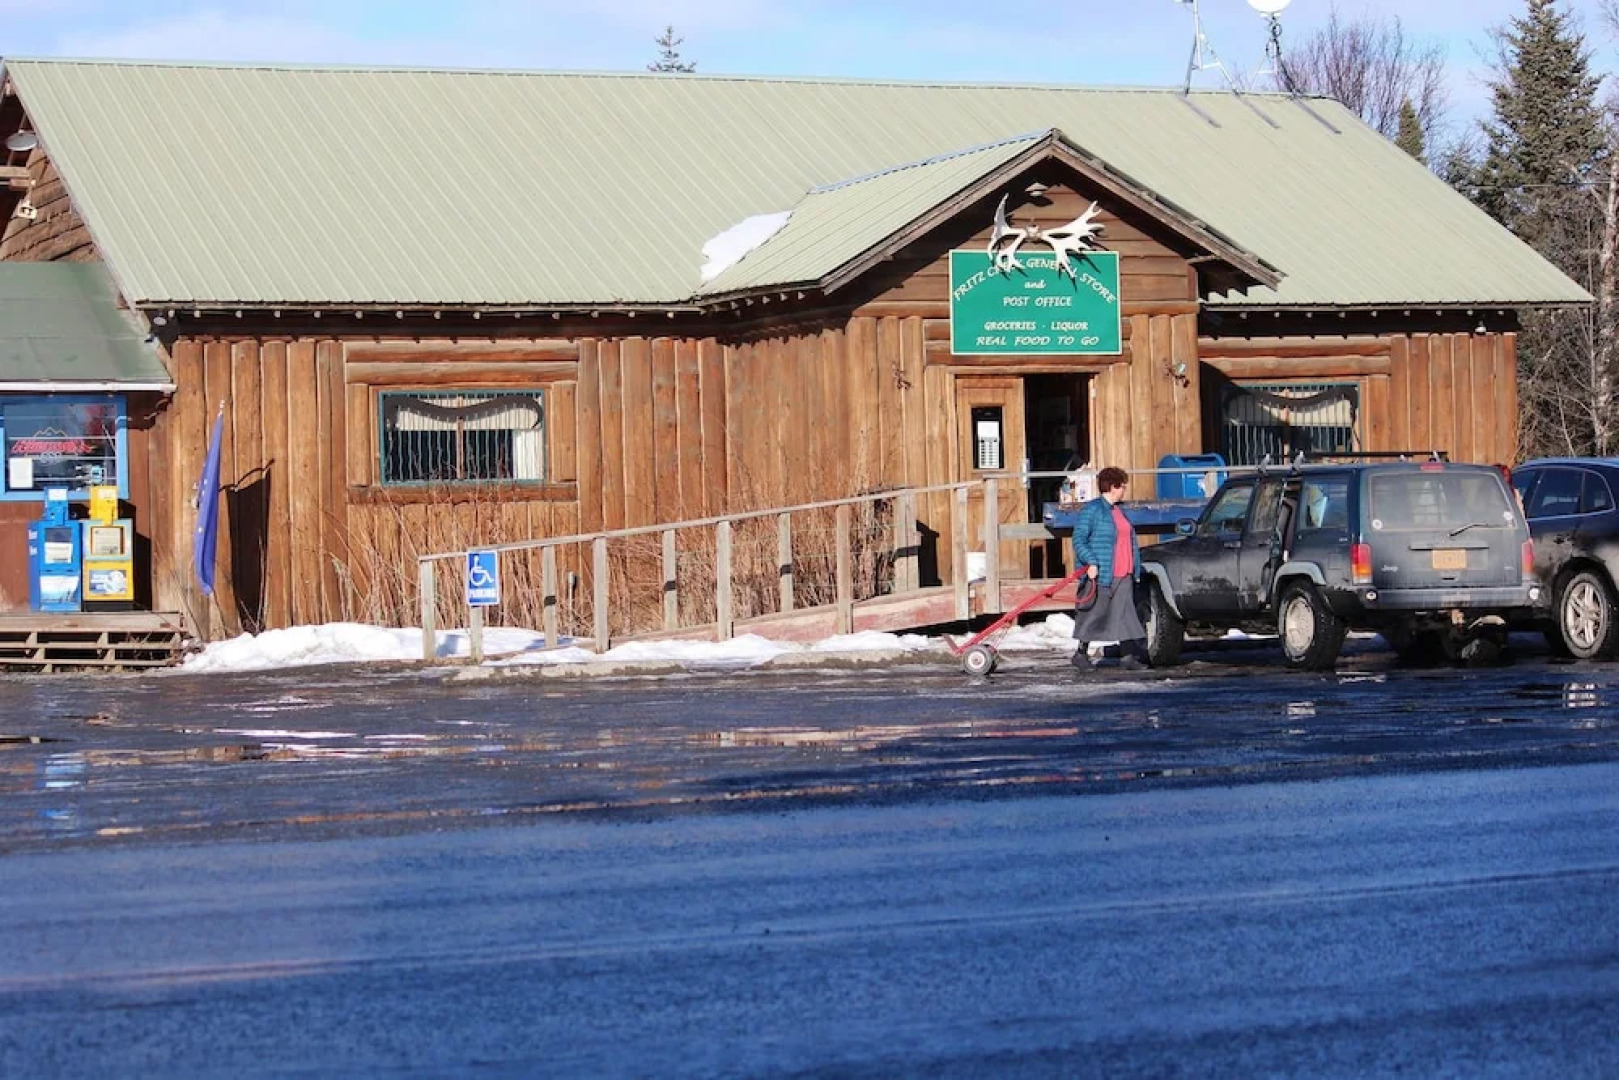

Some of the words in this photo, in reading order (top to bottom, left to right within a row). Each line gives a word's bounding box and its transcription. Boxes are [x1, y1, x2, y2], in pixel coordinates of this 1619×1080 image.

[954, 271, 986, 301] FRITZ
[1079, 272, 1116, 304] STORE
[1024, 279, 1046, 289] and
[1003, 296, 1030, 307] POST
[1034, 296, 1073, 307] OFFICE
[984, 321, 1037, 331] GROCERIES
[1050, 321, 1089, 332] LIQUOR
[976, 336, 1007, 346] REAL
[1014, 336, 1051, 346] FOOD
[1057, 336, 1075, 346] TO
[1080, 336, 1100, 346] GO
